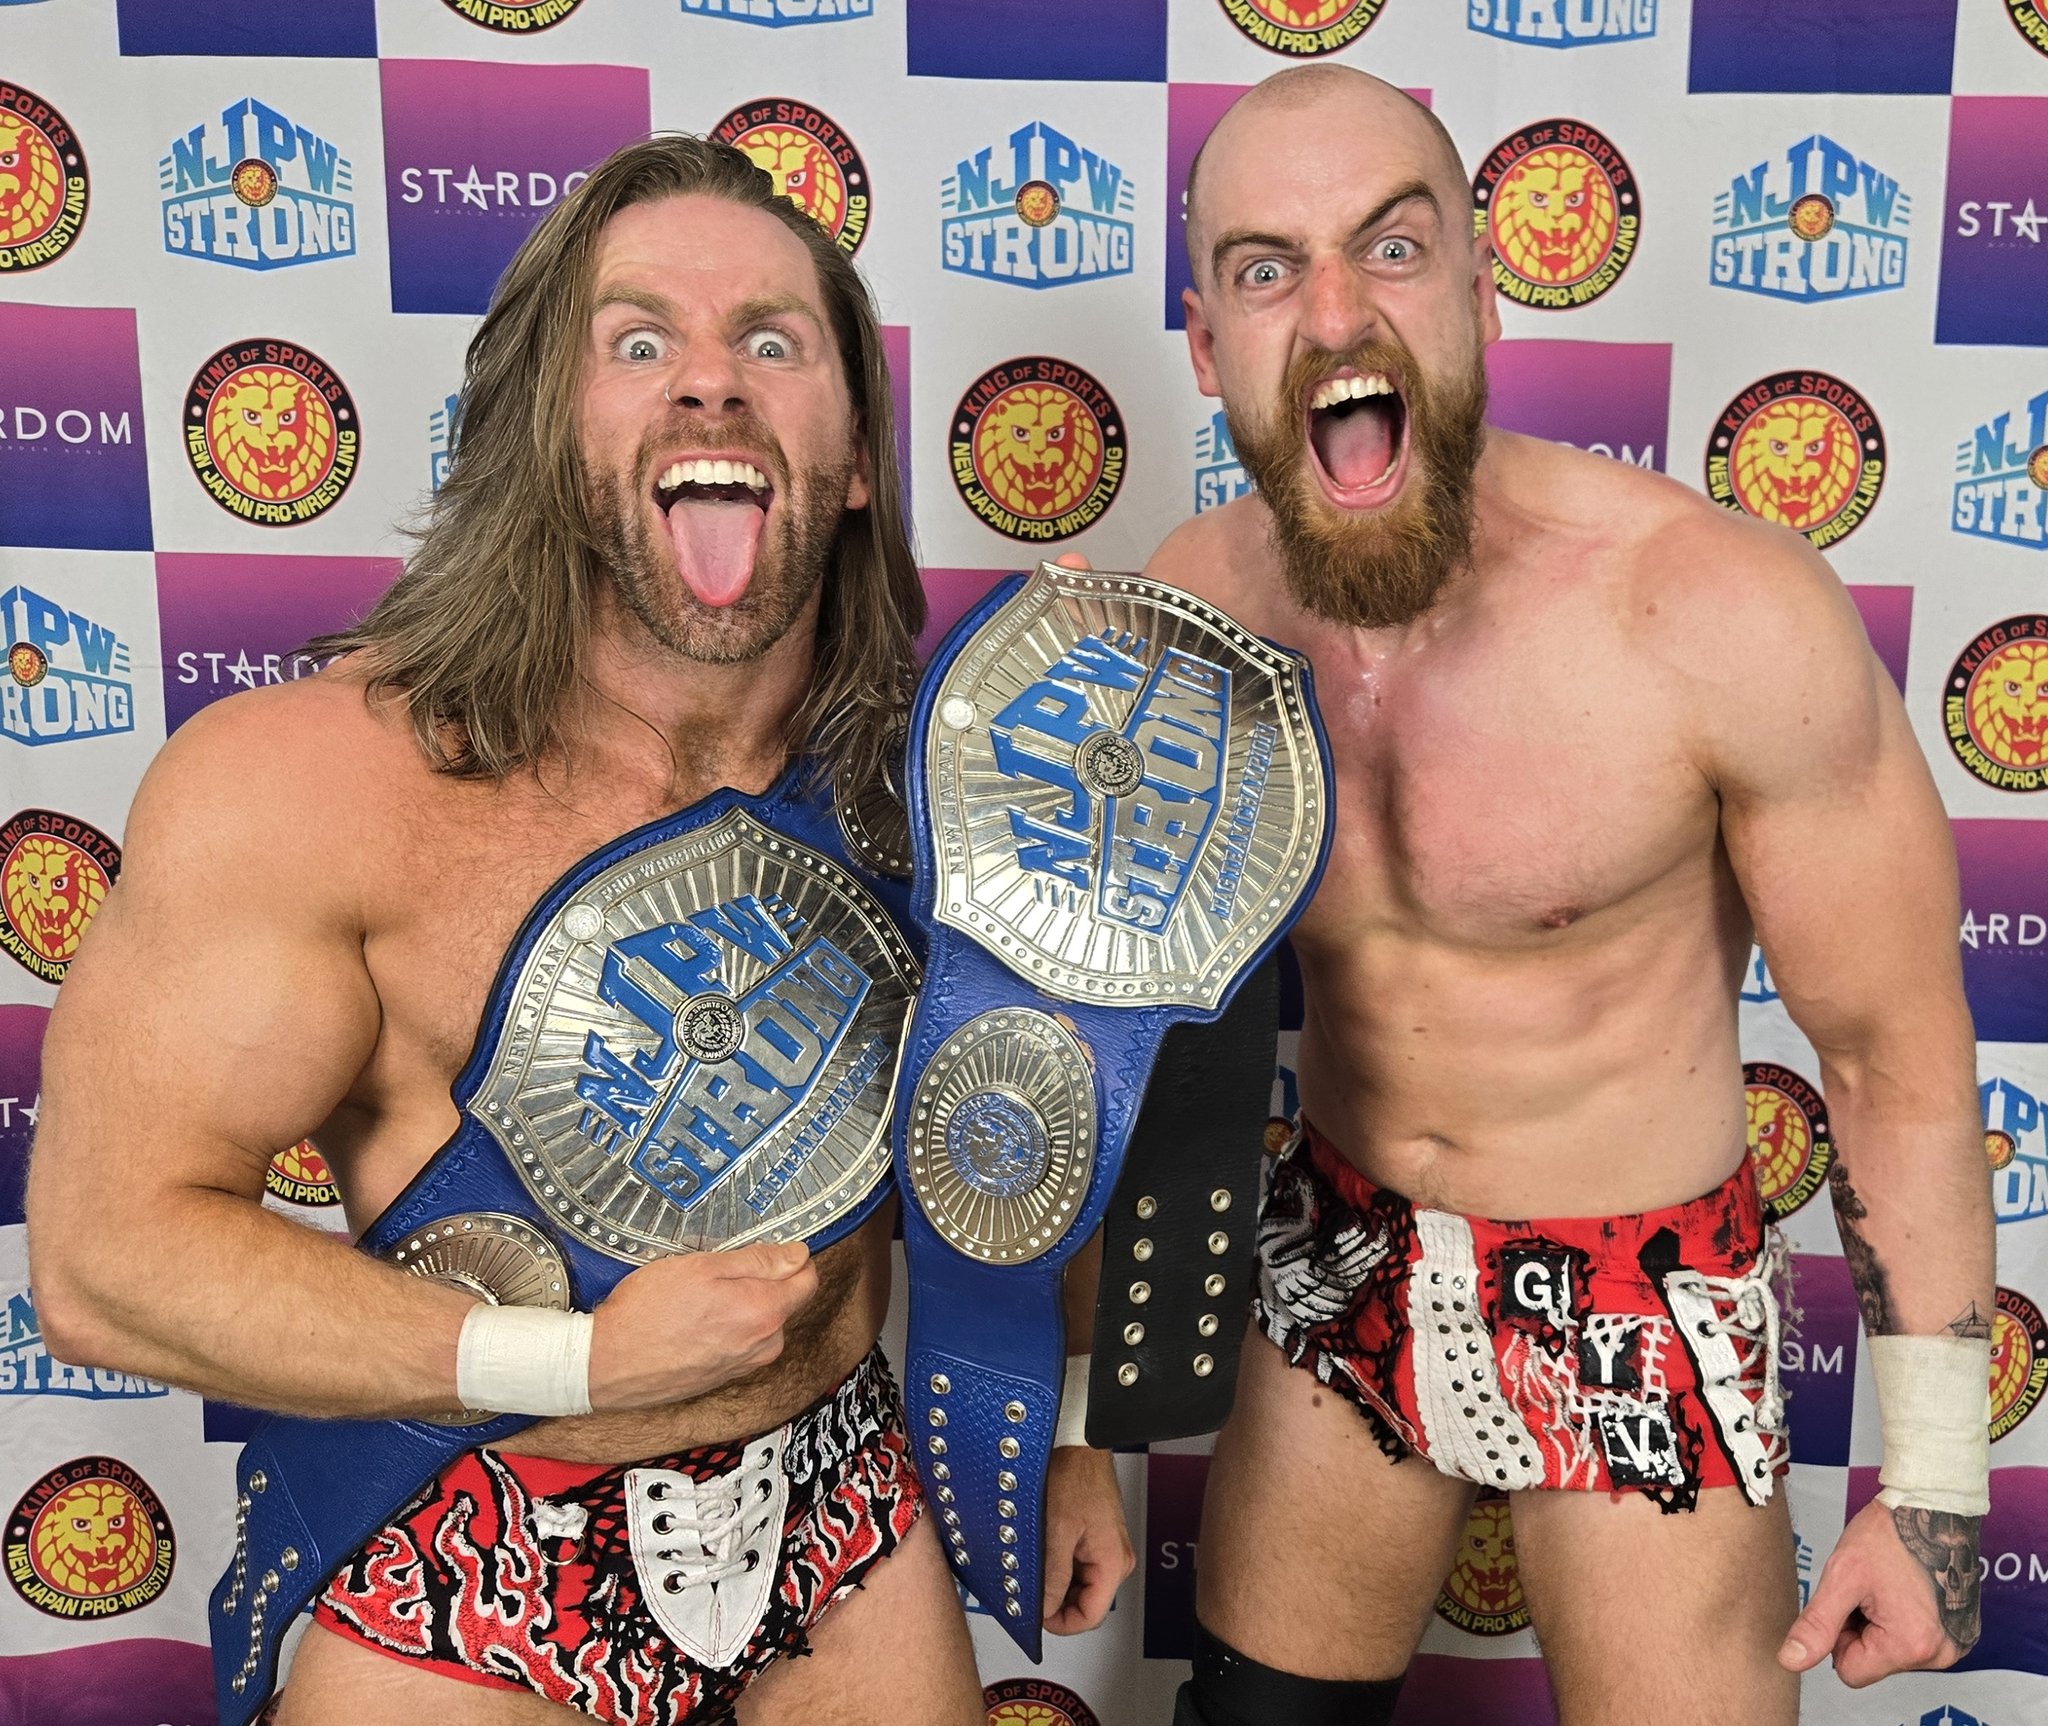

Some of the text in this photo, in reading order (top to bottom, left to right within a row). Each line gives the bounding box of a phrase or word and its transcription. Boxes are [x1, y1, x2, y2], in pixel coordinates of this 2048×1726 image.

[0, 86, 69, 148] PORTS
[173, 97, 338, 196] NJPW
[752, 108, 771, 123] OF
[776, 104, 854, 165] SPORTS
[956, 120, 1122, 215] NJPW
[1482, 124, 1628, 187] KING OF SPORTS
[1730, 134, 1899, 229] NJPW
[0, 176, 85, 268] O-WRESTLING
[166, 197, 352, 261] STRONG
[946, 219, 1130, 280] STRONG
[1530, 214, 1638, 306] PRO-WRESTLING
[1714, 228, 1904, 294] STRONG
[195, 344, 343, 402] KING OF SPORTS
[963, 362, 1112, 419] KING OF SPORTS
[1723, 375, 1873, 432] KING OF SPORTS
[188, 425, 212, 470] NEW
[202, 466, 256, 519] JAPAN
[254, 430, 357, 523] PRO-WRESTLING
[953, 441, 1124, 539] NEW JAPAN PRO-WRESTLING
[1709, 455, 1730, 500] NEW
[1809, 459, 1883, 548] WRESTLING
[1961, 627, 2007, 673] KING
[2010, 623, 2030, 638] OF
[0, 674, 130, 738] RONG
[1946, 695, 2001, 784] NEW JAPAN
[1102, 652, 1225, 927] STRONG
[23, 818, 36, 830] OF
[38, 815, 119, 869] SPORTS
[523, 944, 565, 1019] JAPAN
[636, 946, 865, 1199] STRONG
[1754, 1066, 1821, 1118] SPORTS
[1774, 1142, 1830, 1217] RESTLING
[1996, 1291, 2041, 1335] PORTS
[1987, 1357, 2048, 1440] WRESTLING
[19, 1461, 158, 1519] KING OF SPORTS
[7, 1539, 172, 1616] NEW JAPAN PRO-WRESTLING
